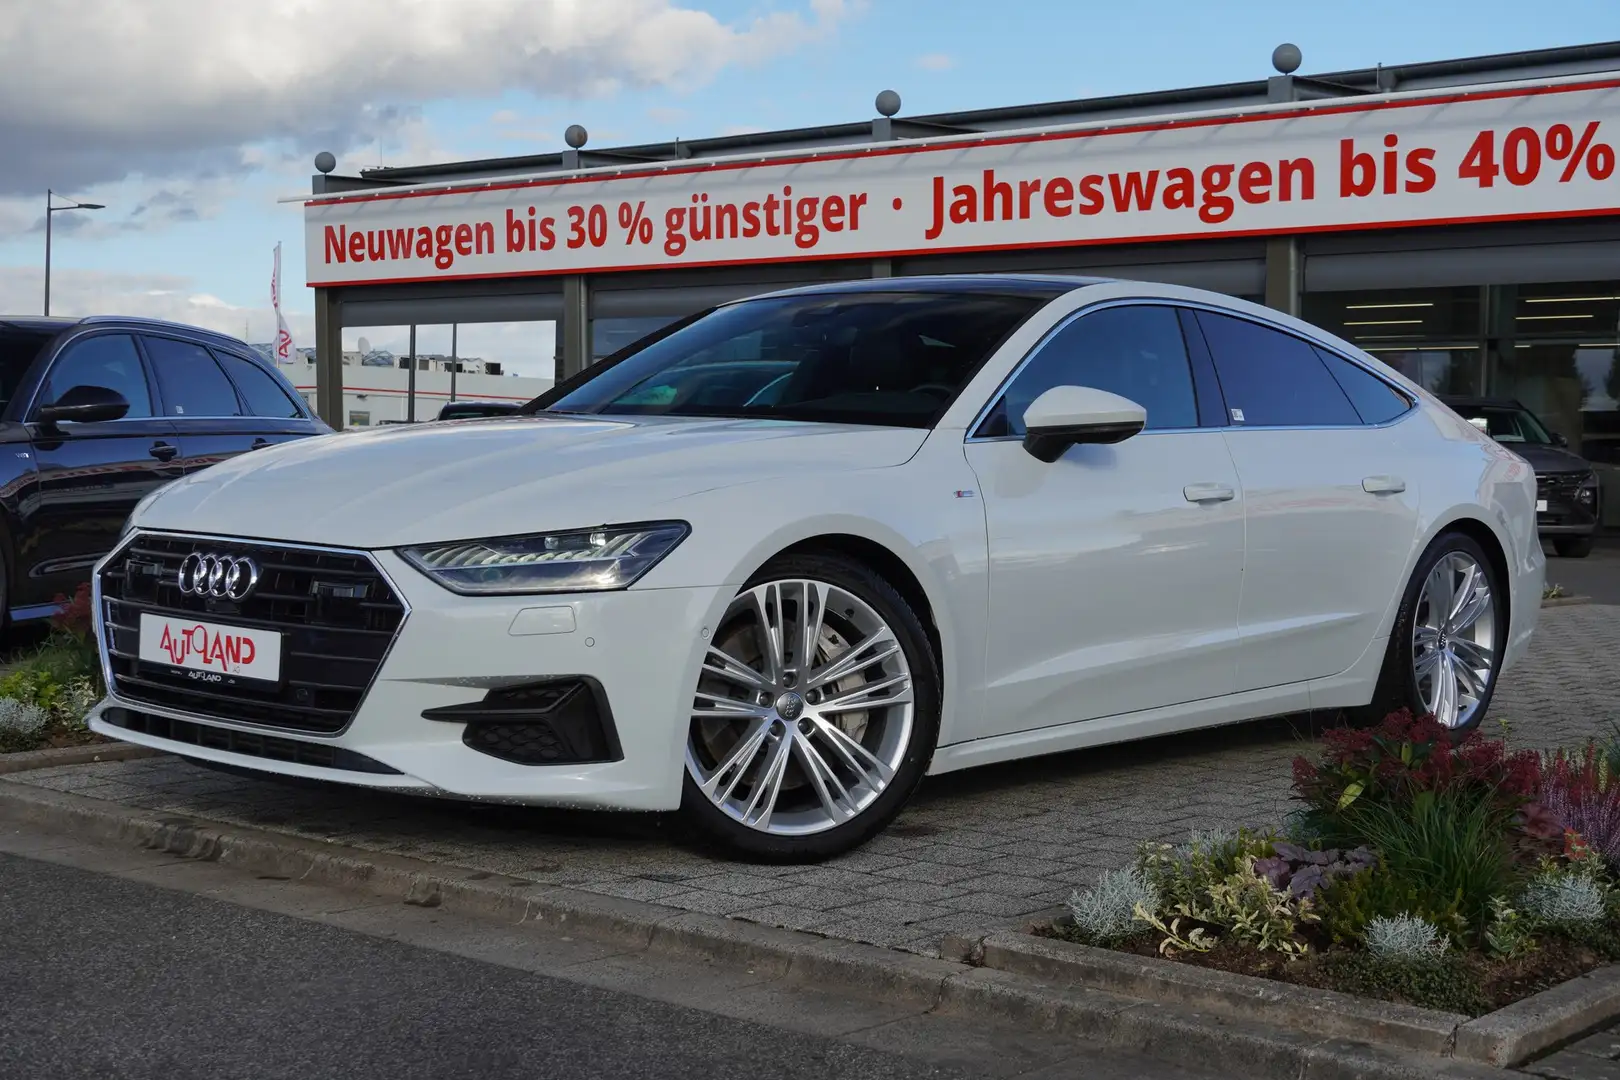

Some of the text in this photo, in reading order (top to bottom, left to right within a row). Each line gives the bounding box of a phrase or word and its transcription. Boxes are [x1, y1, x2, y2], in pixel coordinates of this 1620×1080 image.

[324, 222, 495, 269] Neuwagen
[505, 206, 557, 252] bis
[566, 204, 608, 249] 30
[617, 201, 654, 245] %
[663, 185, 868, 256] günstiger
[924, 157, 1316, 241] Jahreswagen
[1339, 133, 1437, 198] bis
[1458, 121, 1616, 189] 40%
[160, 622, 256, 672] AUTOLAND
